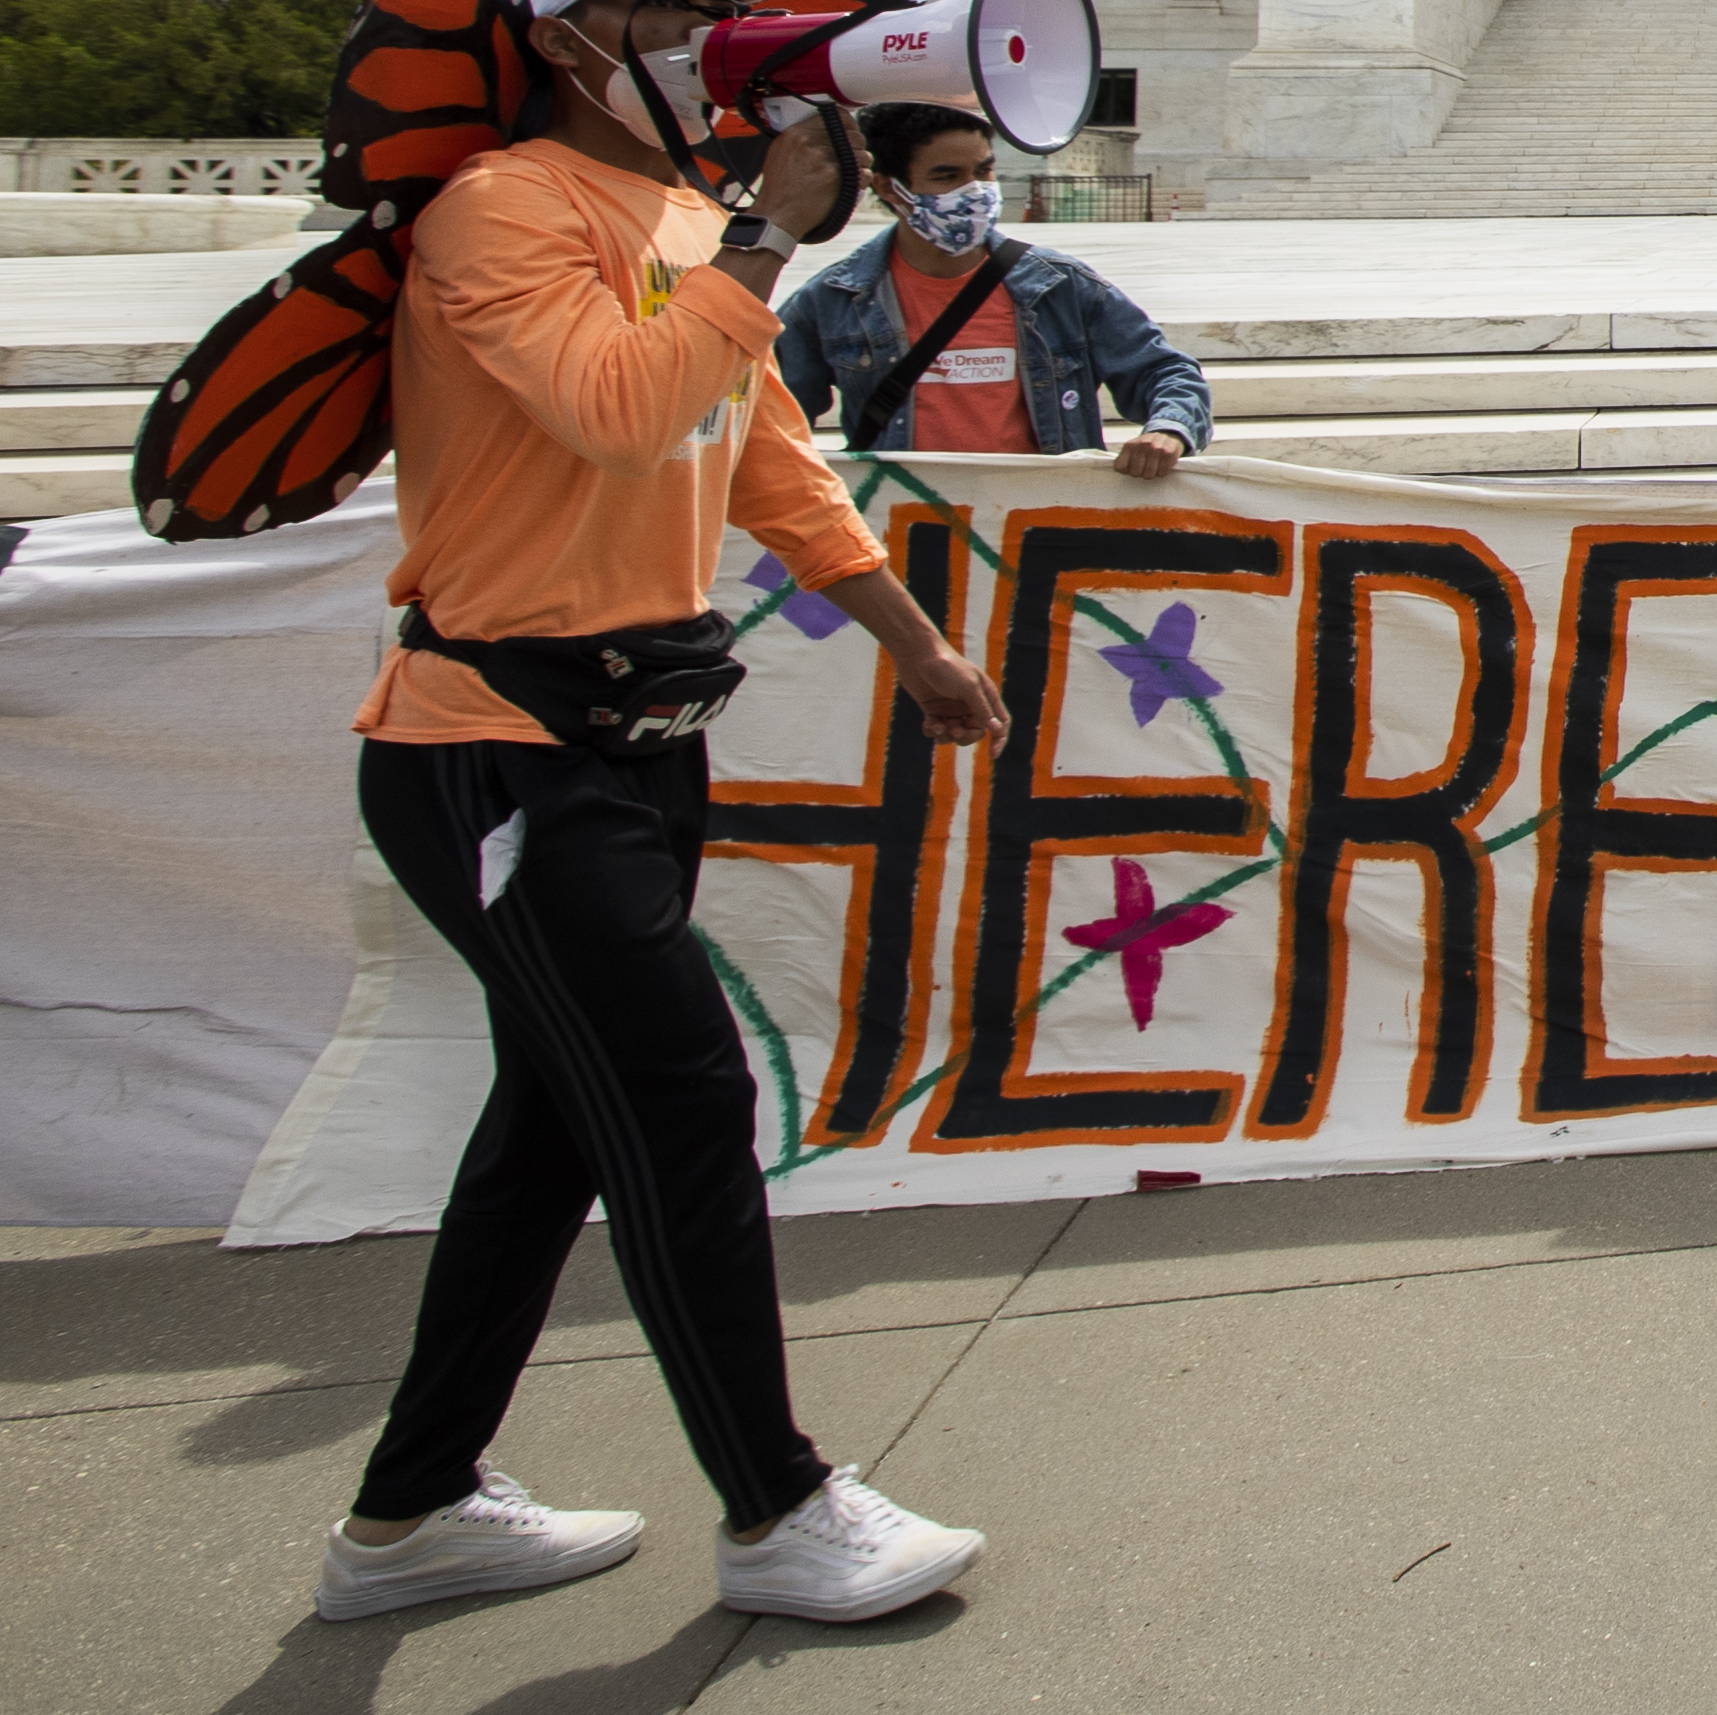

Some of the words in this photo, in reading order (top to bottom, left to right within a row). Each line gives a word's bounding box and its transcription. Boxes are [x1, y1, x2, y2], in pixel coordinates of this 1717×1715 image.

[882, 31, 929, 53] PYLE
[955, 355, 1006, 365] Dream
[948, 366, 1004, 379] ACTION
[627, 694, 727, 741] FILA
